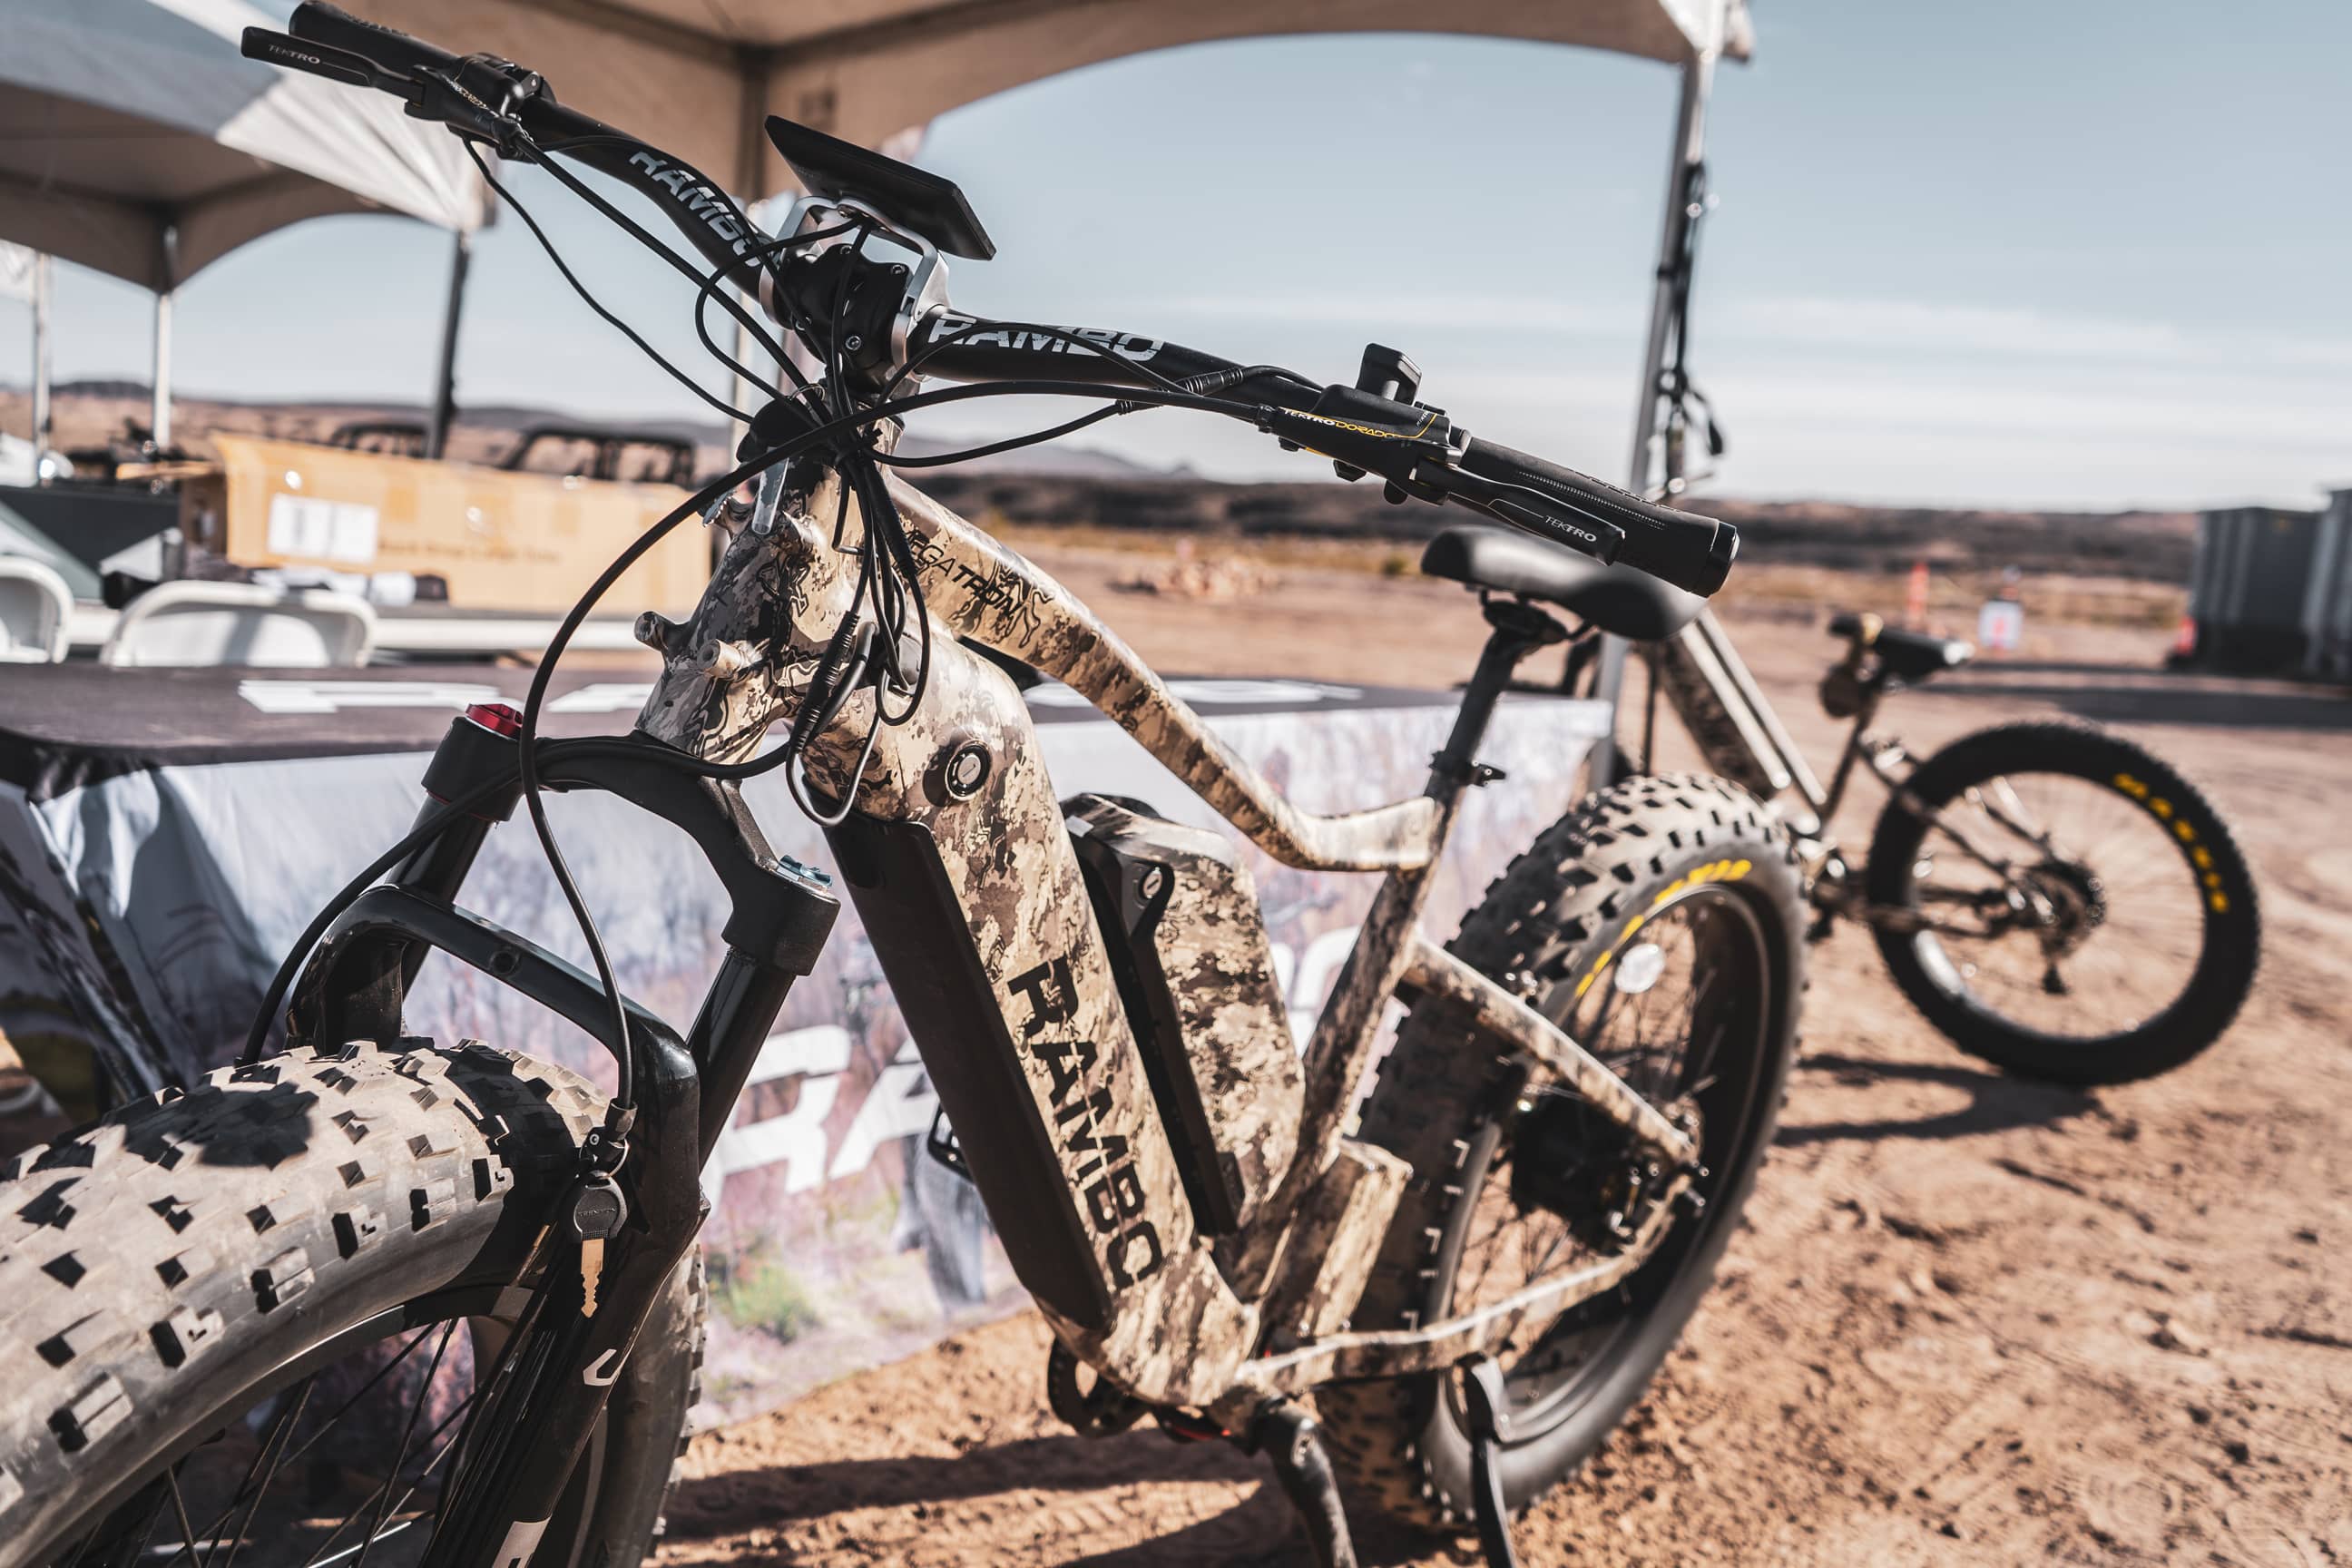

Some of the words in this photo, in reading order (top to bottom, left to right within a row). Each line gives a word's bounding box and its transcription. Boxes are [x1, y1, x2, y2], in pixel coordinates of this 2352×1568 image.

[928, 313, 1164, 362] RAMBO
[1283, 409, 1336, 426] TEKTRO
[1545, 514, 1597, 543] TEKTRO
[907, 528, 1023, 618] EGATRON
[1007, 954, 1162, 1289] RAMBO
